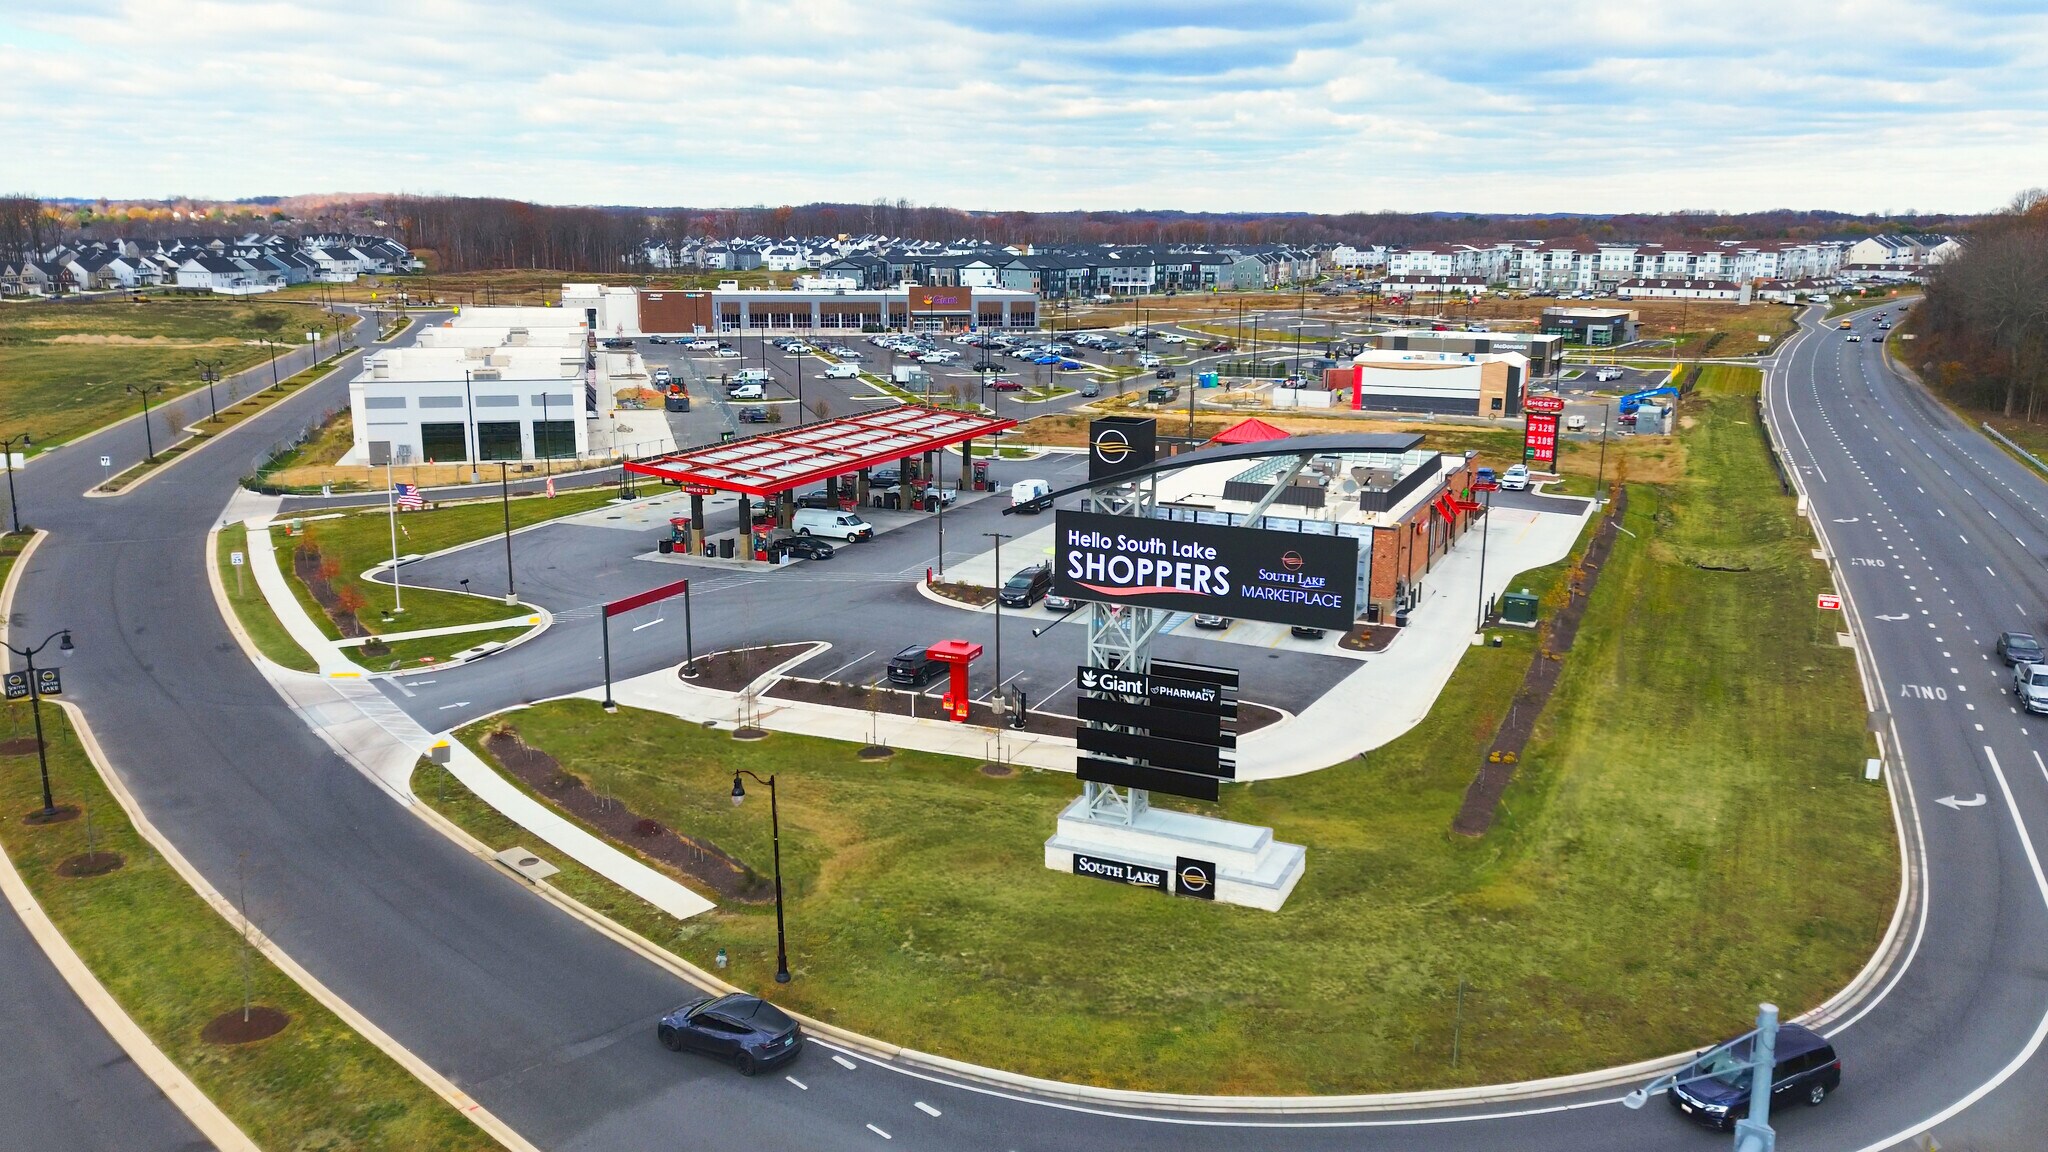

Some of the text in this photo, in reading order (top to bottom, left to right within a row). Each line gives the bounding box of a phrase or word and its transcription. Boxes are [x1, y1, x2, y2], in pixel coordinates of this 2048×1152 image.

[933, 295, 958, 304] Giant
[1068, 529, 1217, 560] Hello South Lake
[1851, 557, 1886, 568] ONLY
[1067, 550, 1230, 596] SHOPPERS
[1241, 585, 1342, 608] MARKETPLACE
[1100, 674, 1143, 694] Giant
[1160, 686, 1216, 702] PHARMACY
[1900, 684, 1948, 701] ONLY
[1078, 857, 1160, 885] SOUTH LAKE
